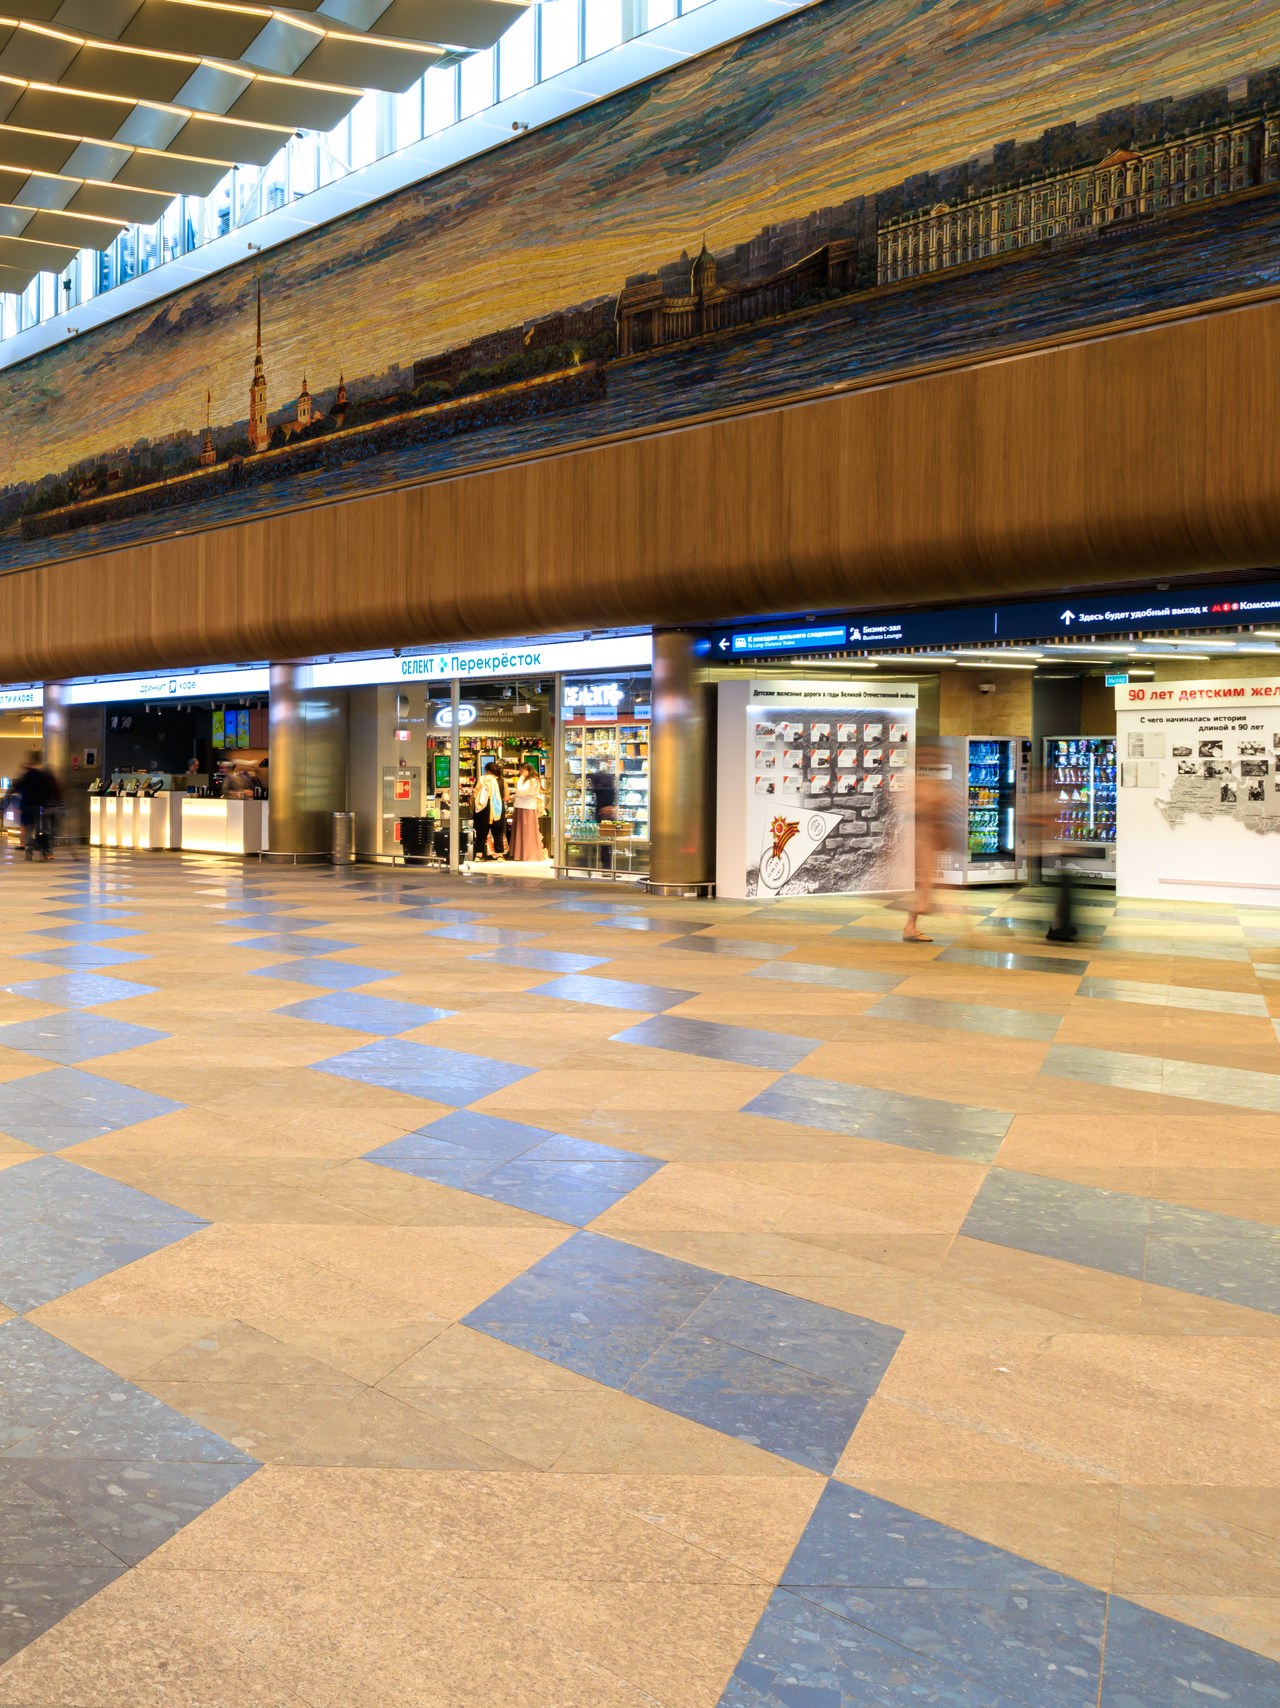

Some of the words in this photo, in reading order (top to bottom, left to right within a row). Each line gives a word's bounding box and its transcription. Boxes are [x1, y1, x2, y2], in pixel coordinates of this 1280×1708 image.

[1078, 613, 1104, 622] Здесь
[1105, 611, 1128, 620] будет
[1130, 608, 1170, 620] удобный
[1172, 607, 1201, 616] выход
[1240, 601, 1280, 610] Комсом
[753, 634, 778, 642] поездам
[778, 632, 806, 640] дальнего
[807, 630, 844, 638] следования
[863, 625, 901, 634] Бизнес-зал
[402, 658, 434, 674] СЕЛЕКТ
[451, 653, 541, 673] Перекрёсток
[1128, 689, 1145, 700] 90
[1150, 690, 1174, 700] лет
[1179, 687, 1245, 700] детским
